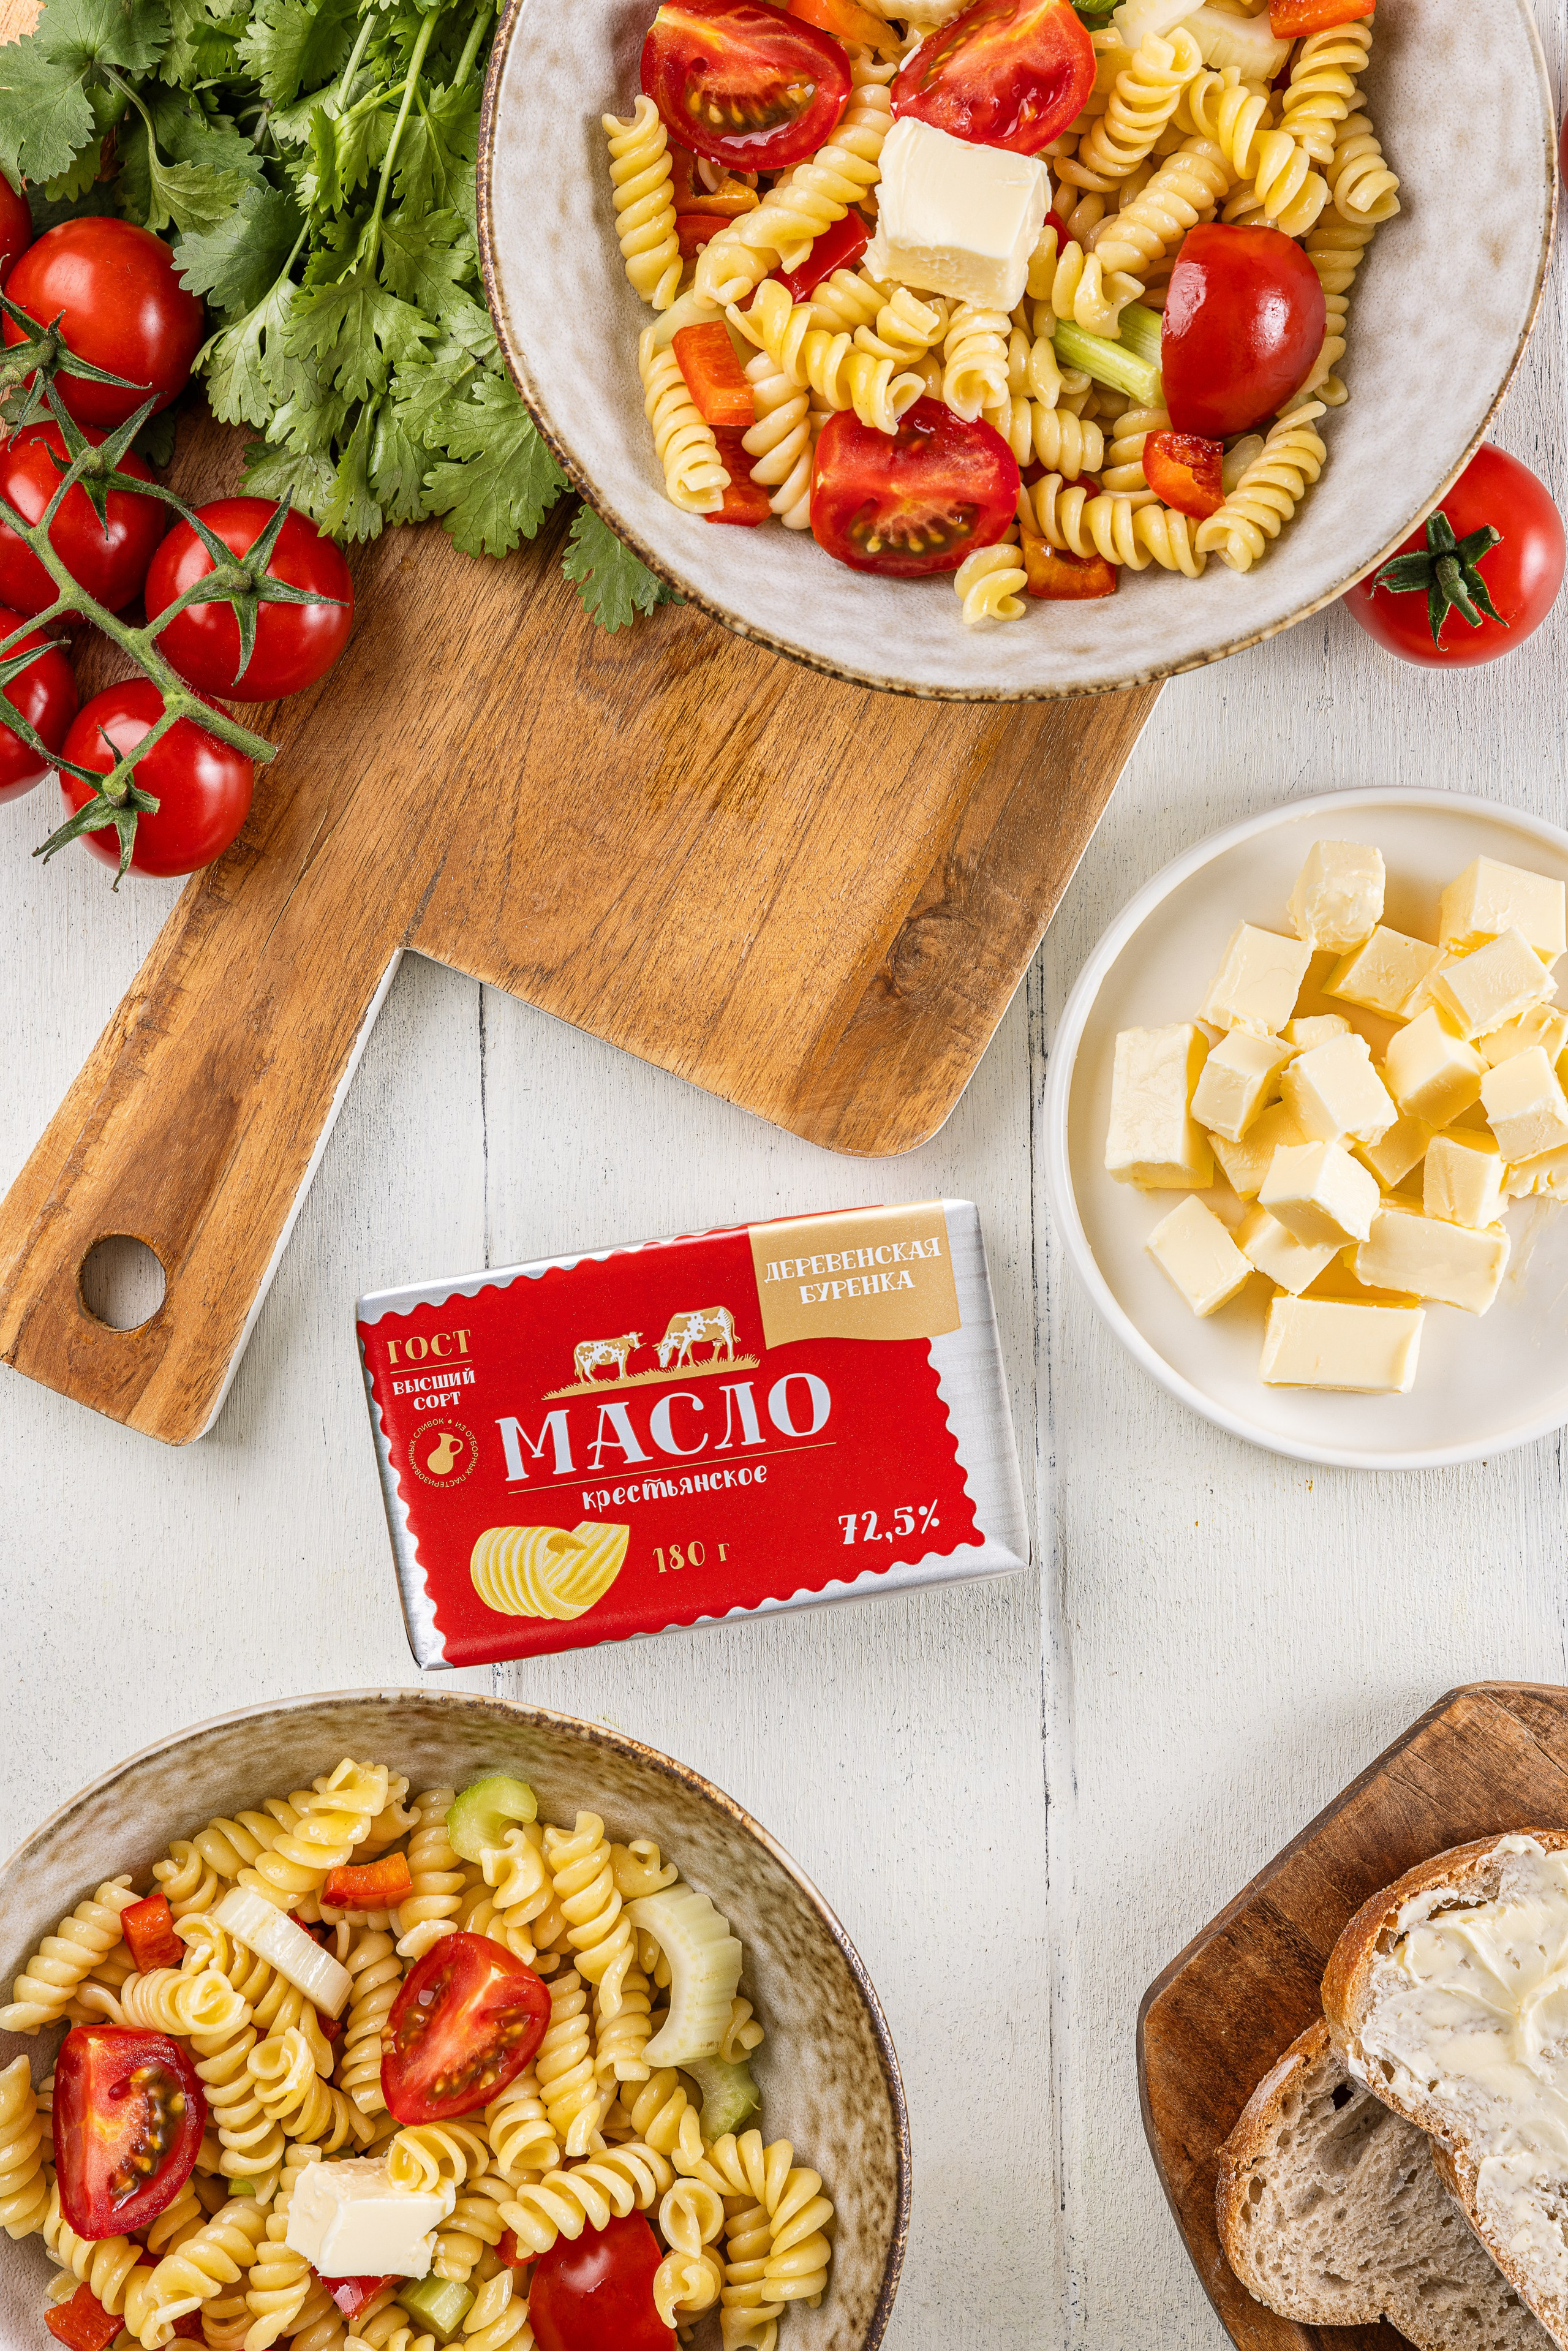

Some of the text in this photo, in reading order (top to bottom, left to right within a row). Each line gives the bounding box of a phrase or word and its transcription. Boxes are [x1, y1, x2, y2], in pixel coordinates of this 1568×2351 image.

[764, 1237, 942, 1283] ДЕРЕВЕНСКАЯ
[799, 1270, 916, 1304] БУРЕНКА
[386, 1329, 471, 1364] ГОСТ
[392, 1367, 476, 1395] ВЫСШИЙ
[413, 1391, 461, 1410] СОРТ
[495, 1373, 831, 1481] МАСЛО
[408, 1418, 478, 1488] ИЗ ОТБОРНЫХ ПАСТЕРИЗОВАННЫХ СЛИВОК
[582, 1465, 767, 1512] крестьянское
[839, 1499, 940, 1545] 72,5%
[653, 1541, 729, 1573] 180 г
